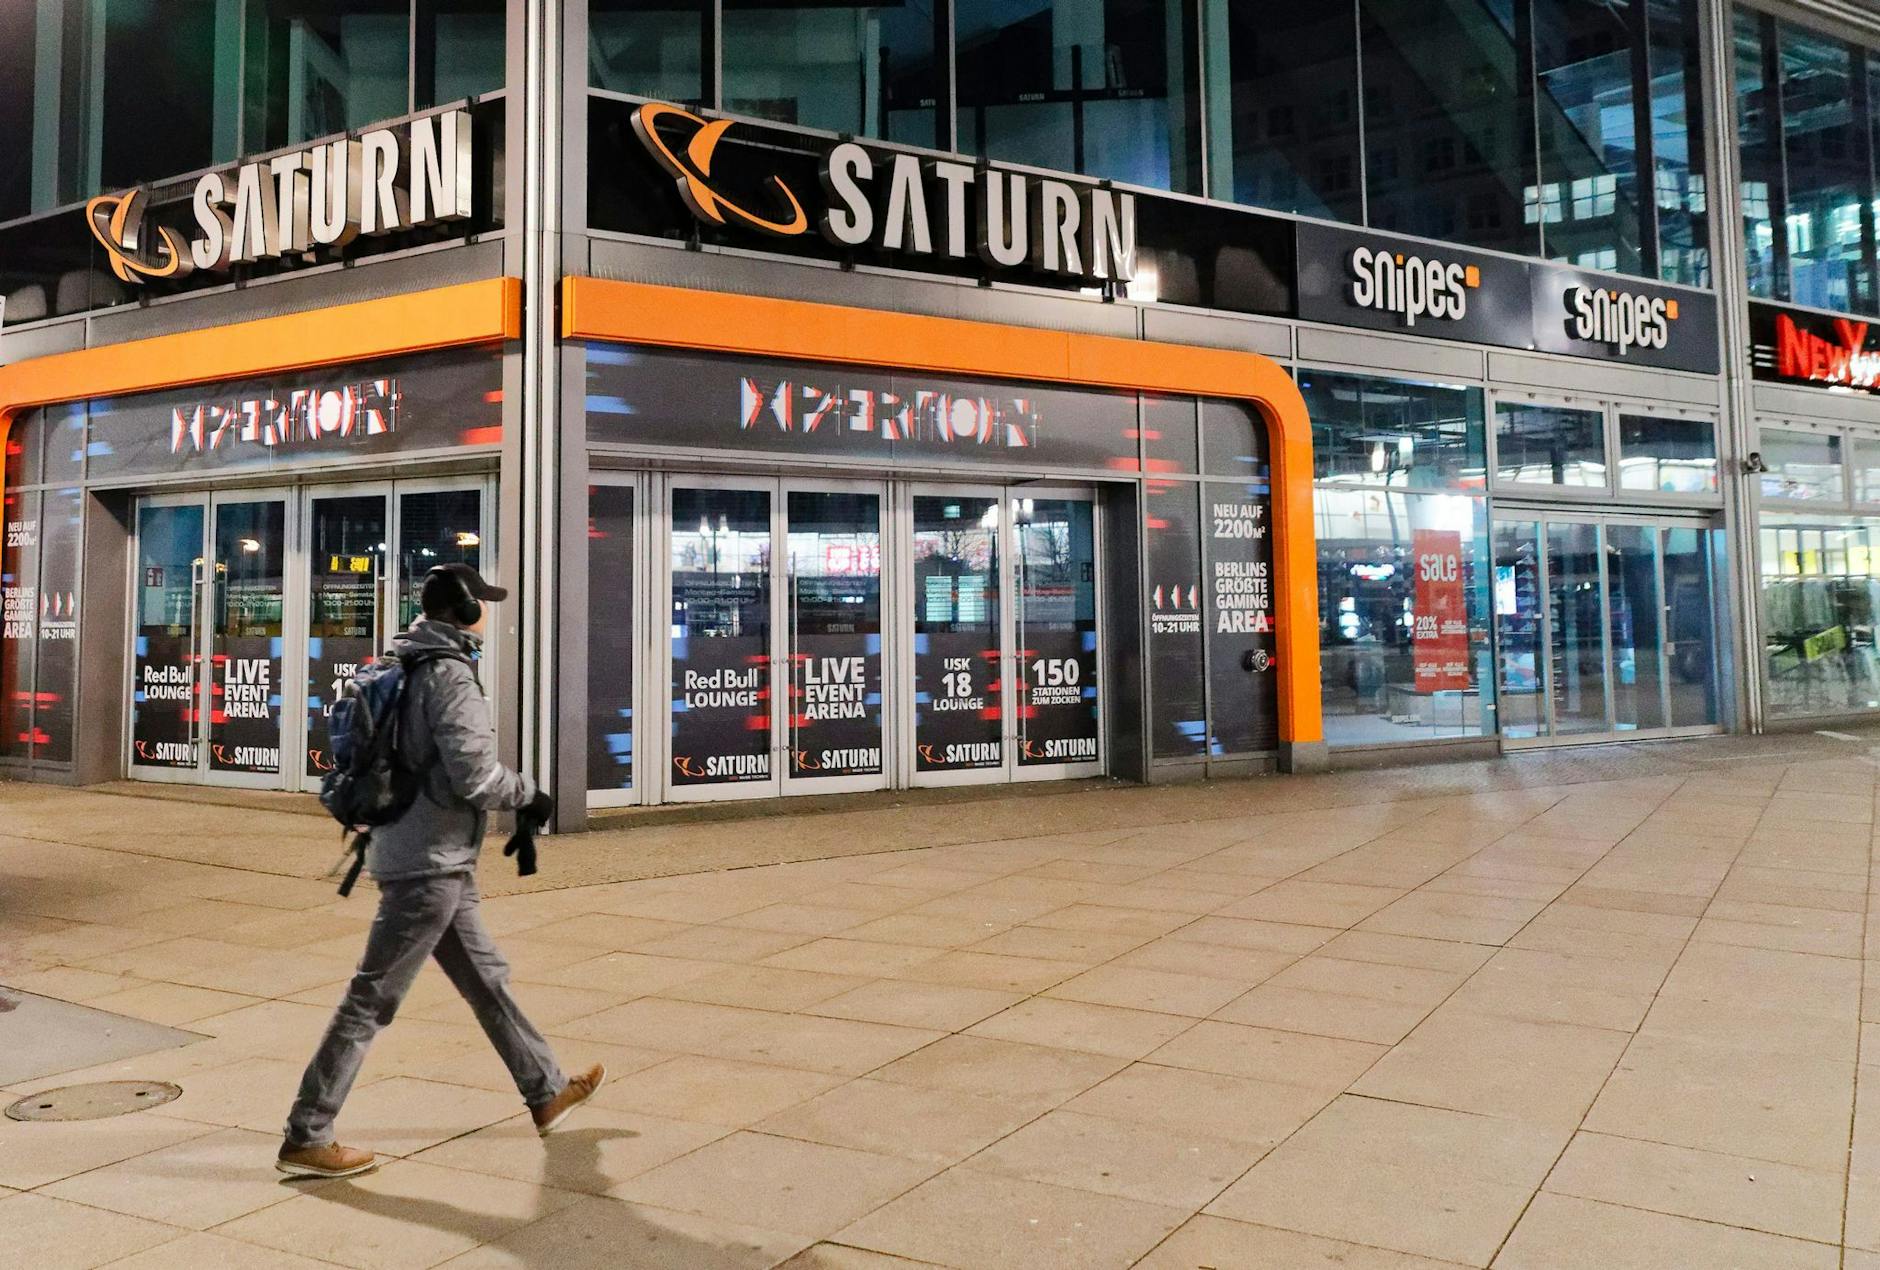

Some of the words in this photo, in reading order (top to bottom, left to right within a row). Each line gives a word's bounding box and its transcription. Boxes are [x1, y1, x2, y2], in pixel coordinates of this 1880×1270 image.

[191, 110, 471, 270] SATURN
[827, 142, 1136, 283] SATURN
[1352, 246, 1467, 326] snipes
[1573, 285, 1669, 355] snipes
[1213, 503, 1238, 518] NEU
[1240, 504, 1263, 518] AUF
[8, 521, 22, 532] NEU
[22, 520, 36, 532] AUF
[1215, 561, 1267, 578] BERLINS
[1420, 554, 1457, 582] sale
[5, 587, 35, 598] BERLINS
[1216, 594, 1269, 609] GAMING
[4, 610, 34, 621] GAMING
[1217, 610, 1269, 634] AREA
[1416, 616, 1438, 631] 20%
[3, 621, 33, 639] AREA
[60, 628, 76, 639] UHR
[1152, 622, 1179, 633] 10-21
[1180, 622, 1200, 633] UHR
[224, 659, 270, 684] LIVE
[333, 663, 358, 677] USK
[805, 657, 865, 685] LIVE
[944, 658, 971, 671] USK
[1031, 658, 1080, 686] 150
[144, 665, 168, 683] Red
[685, 669, 720, 689] Red
[724, 668, 758, 689] Bull
[144, 685, 192, 700] LOUNGE
[224, 684, 270, 702] EVENT
[805, 684, 866, 703] EVENT
[941, 672, 972, 698] 18
[1032, 686, 1081, 697] STATIONEN
[685, 690, 758, 709] LOUNGE
[933, 698, 984, 711] LOUNGE
[1032, 696, 1050, 705] ZUM
[1051, 695, 1081, 705] ZOCKEN
[223, 702, 270, 719] ARENA
[804, 702, 866, 720] ARENA
[234, 746, 279, 767] SATURN
[946, 742, 1000, 763] SATURN
[1045, 738, 1096, 757] SATURN
[706, 754, 769, 776] SATURN
[821, 748, 880, 769] SATURN
